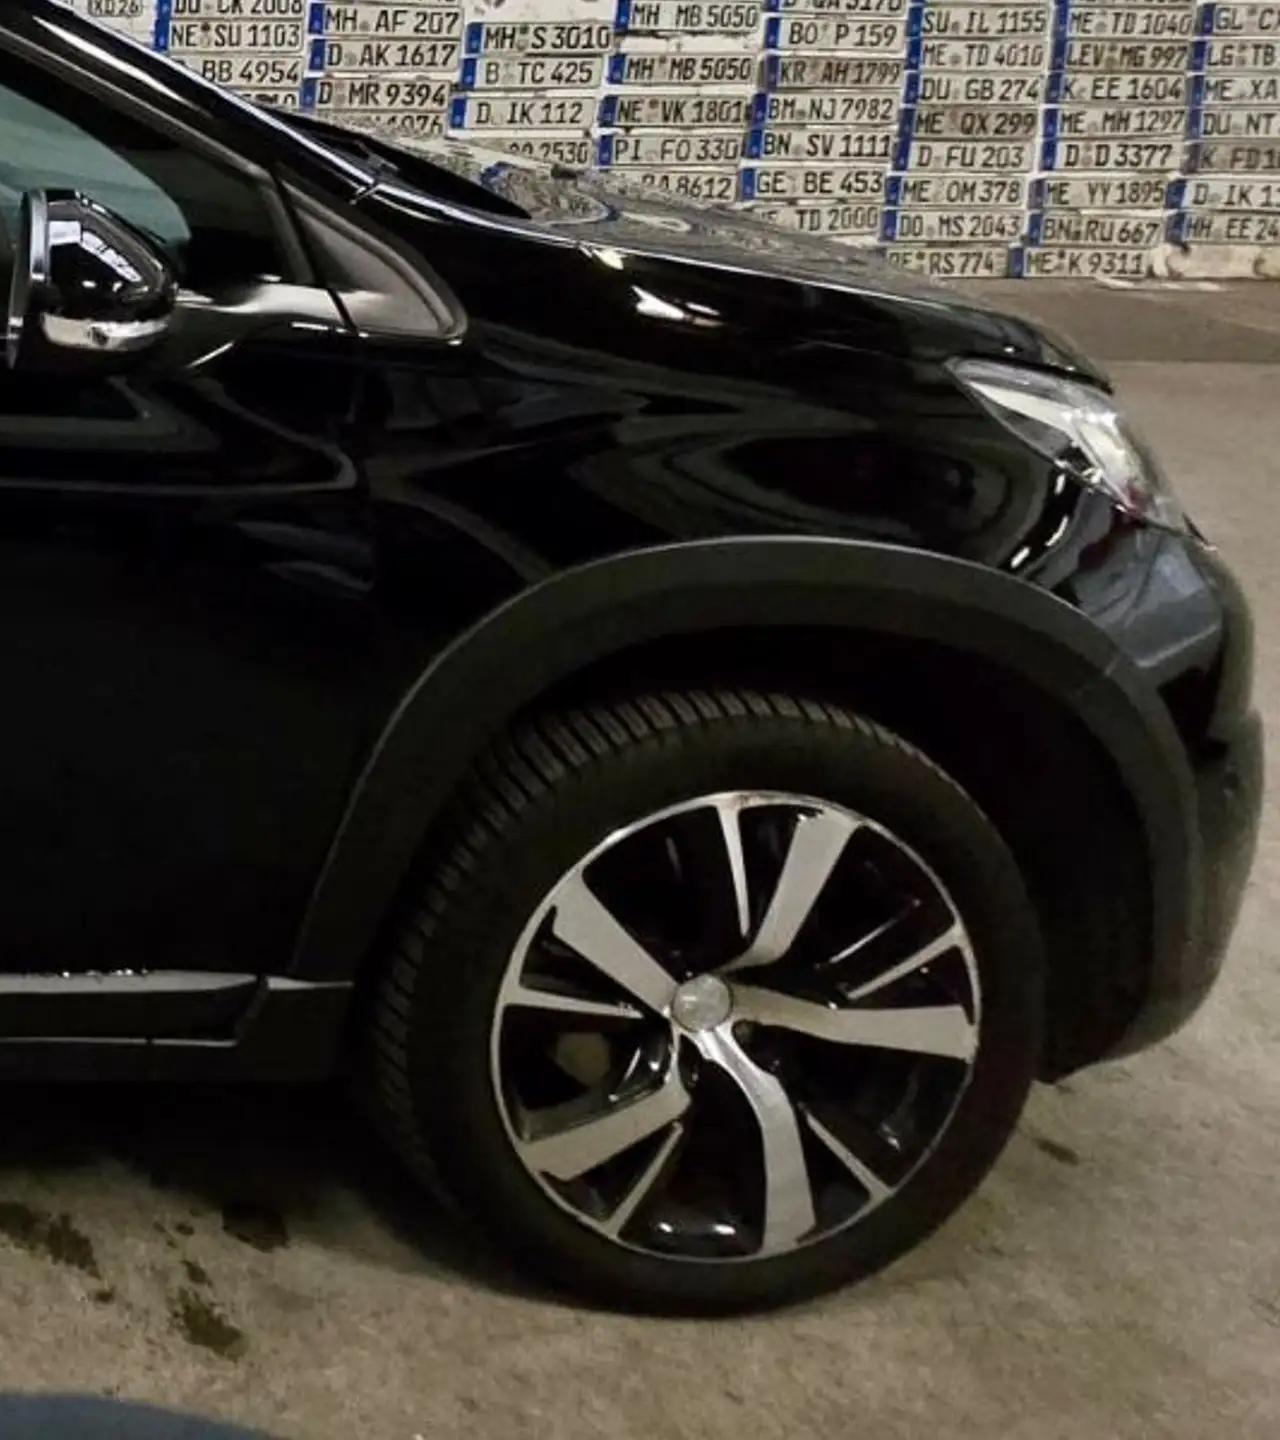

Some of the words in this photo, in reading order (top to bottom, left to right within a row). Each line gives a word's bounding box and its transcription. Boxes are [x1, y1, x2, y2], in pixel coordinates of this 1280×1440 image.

[476, 99, 491, 124] D
[507, 102, 534, 125] IK
[540, 102, 583, 125] 112
[916, 143, 931, 166] D
[945, 144, 977, 167] FU
[981, 144, 1024, 168] 203
